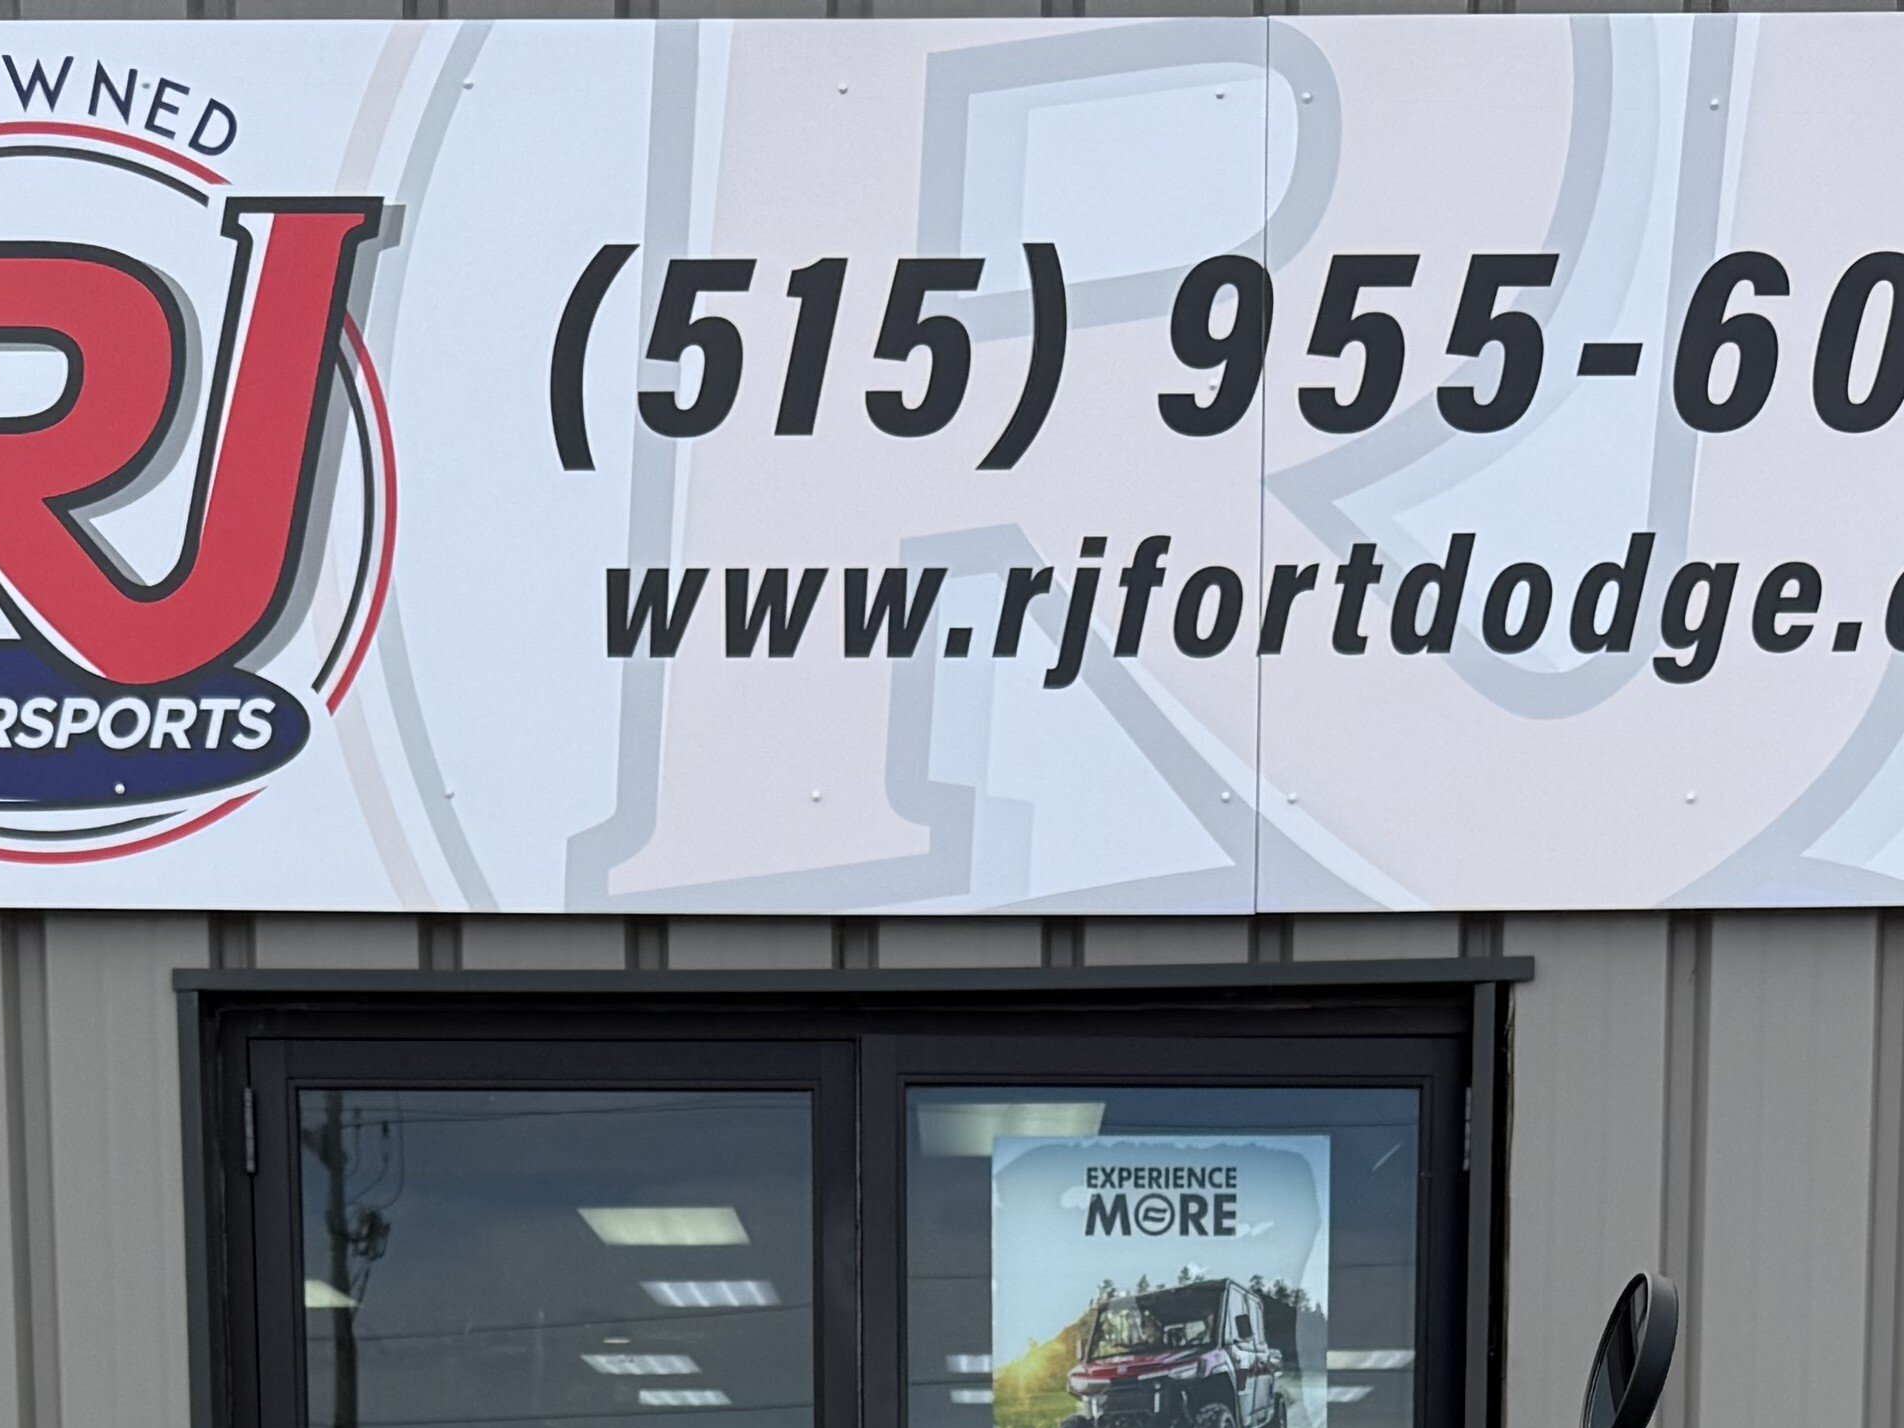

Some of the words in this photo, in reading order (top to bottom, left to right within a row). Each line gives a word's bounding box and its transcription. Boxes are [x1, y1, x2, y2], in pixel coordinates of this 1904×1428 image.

[548, 241, 1072, 472] (515)
[1086, 1166, 1237, 1189] EXPERIENCE
[1085, 1193, 1237, 1237] MORE
